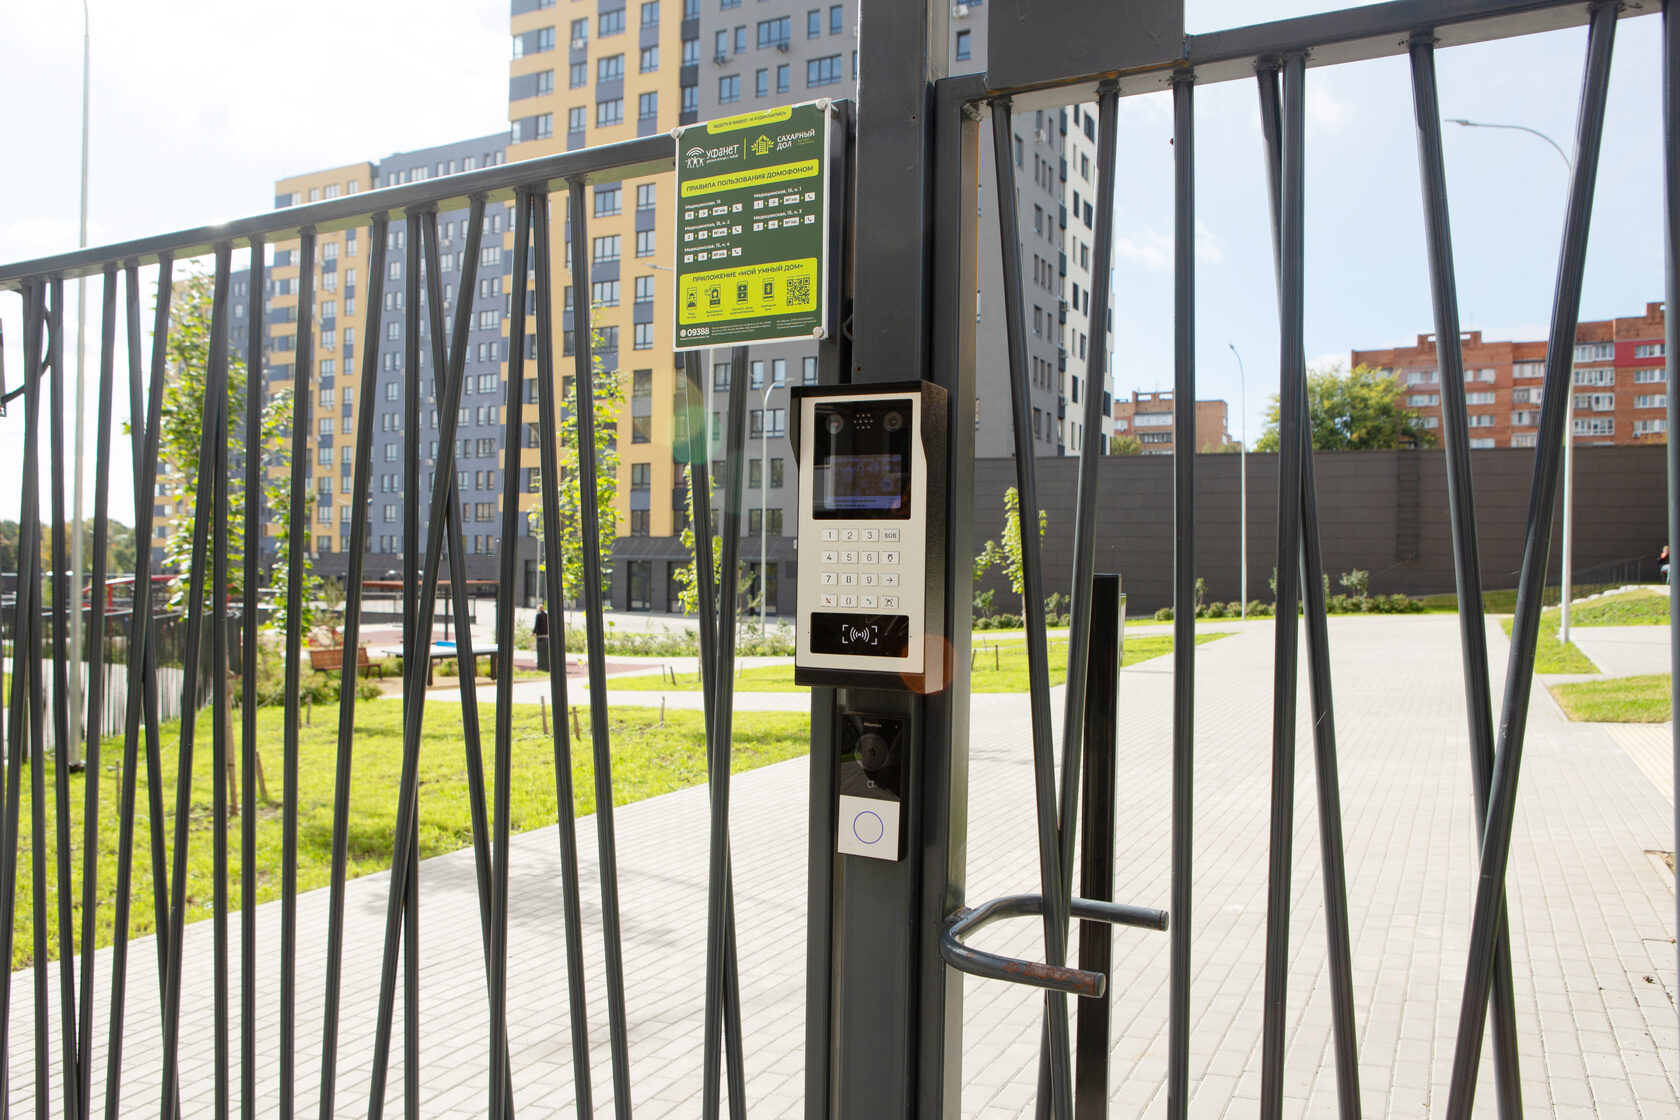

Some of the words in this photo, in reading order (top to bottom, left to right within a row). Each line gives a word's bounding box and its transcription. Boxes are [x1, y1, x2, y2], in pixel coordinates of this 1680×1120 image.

[754, 111, 786, 120] АУДИОЗАПИСЬ
[777, 128, 815, 142] САХАРНЫЙ
[776, 141, 792, 151] ДОЛ
[686, 182, 716, 192] ПРАВИЛА
[717, 174, 766, 187] ПОЛЬЗОВАНИЯ
[766, 166, 813, 179] ДОМОФОНОМ
[692, 272, 736, 282] ПРИЛОЖЕНИЕ
[738, 268, 756, 277] «МОЙ
[757, 266, 783, 274] УМНЫЙ
[784, 264, 804, 272] ДОМ»
[687, 328, 710, 336] 09388
[866, 576, 872, 584] 9
